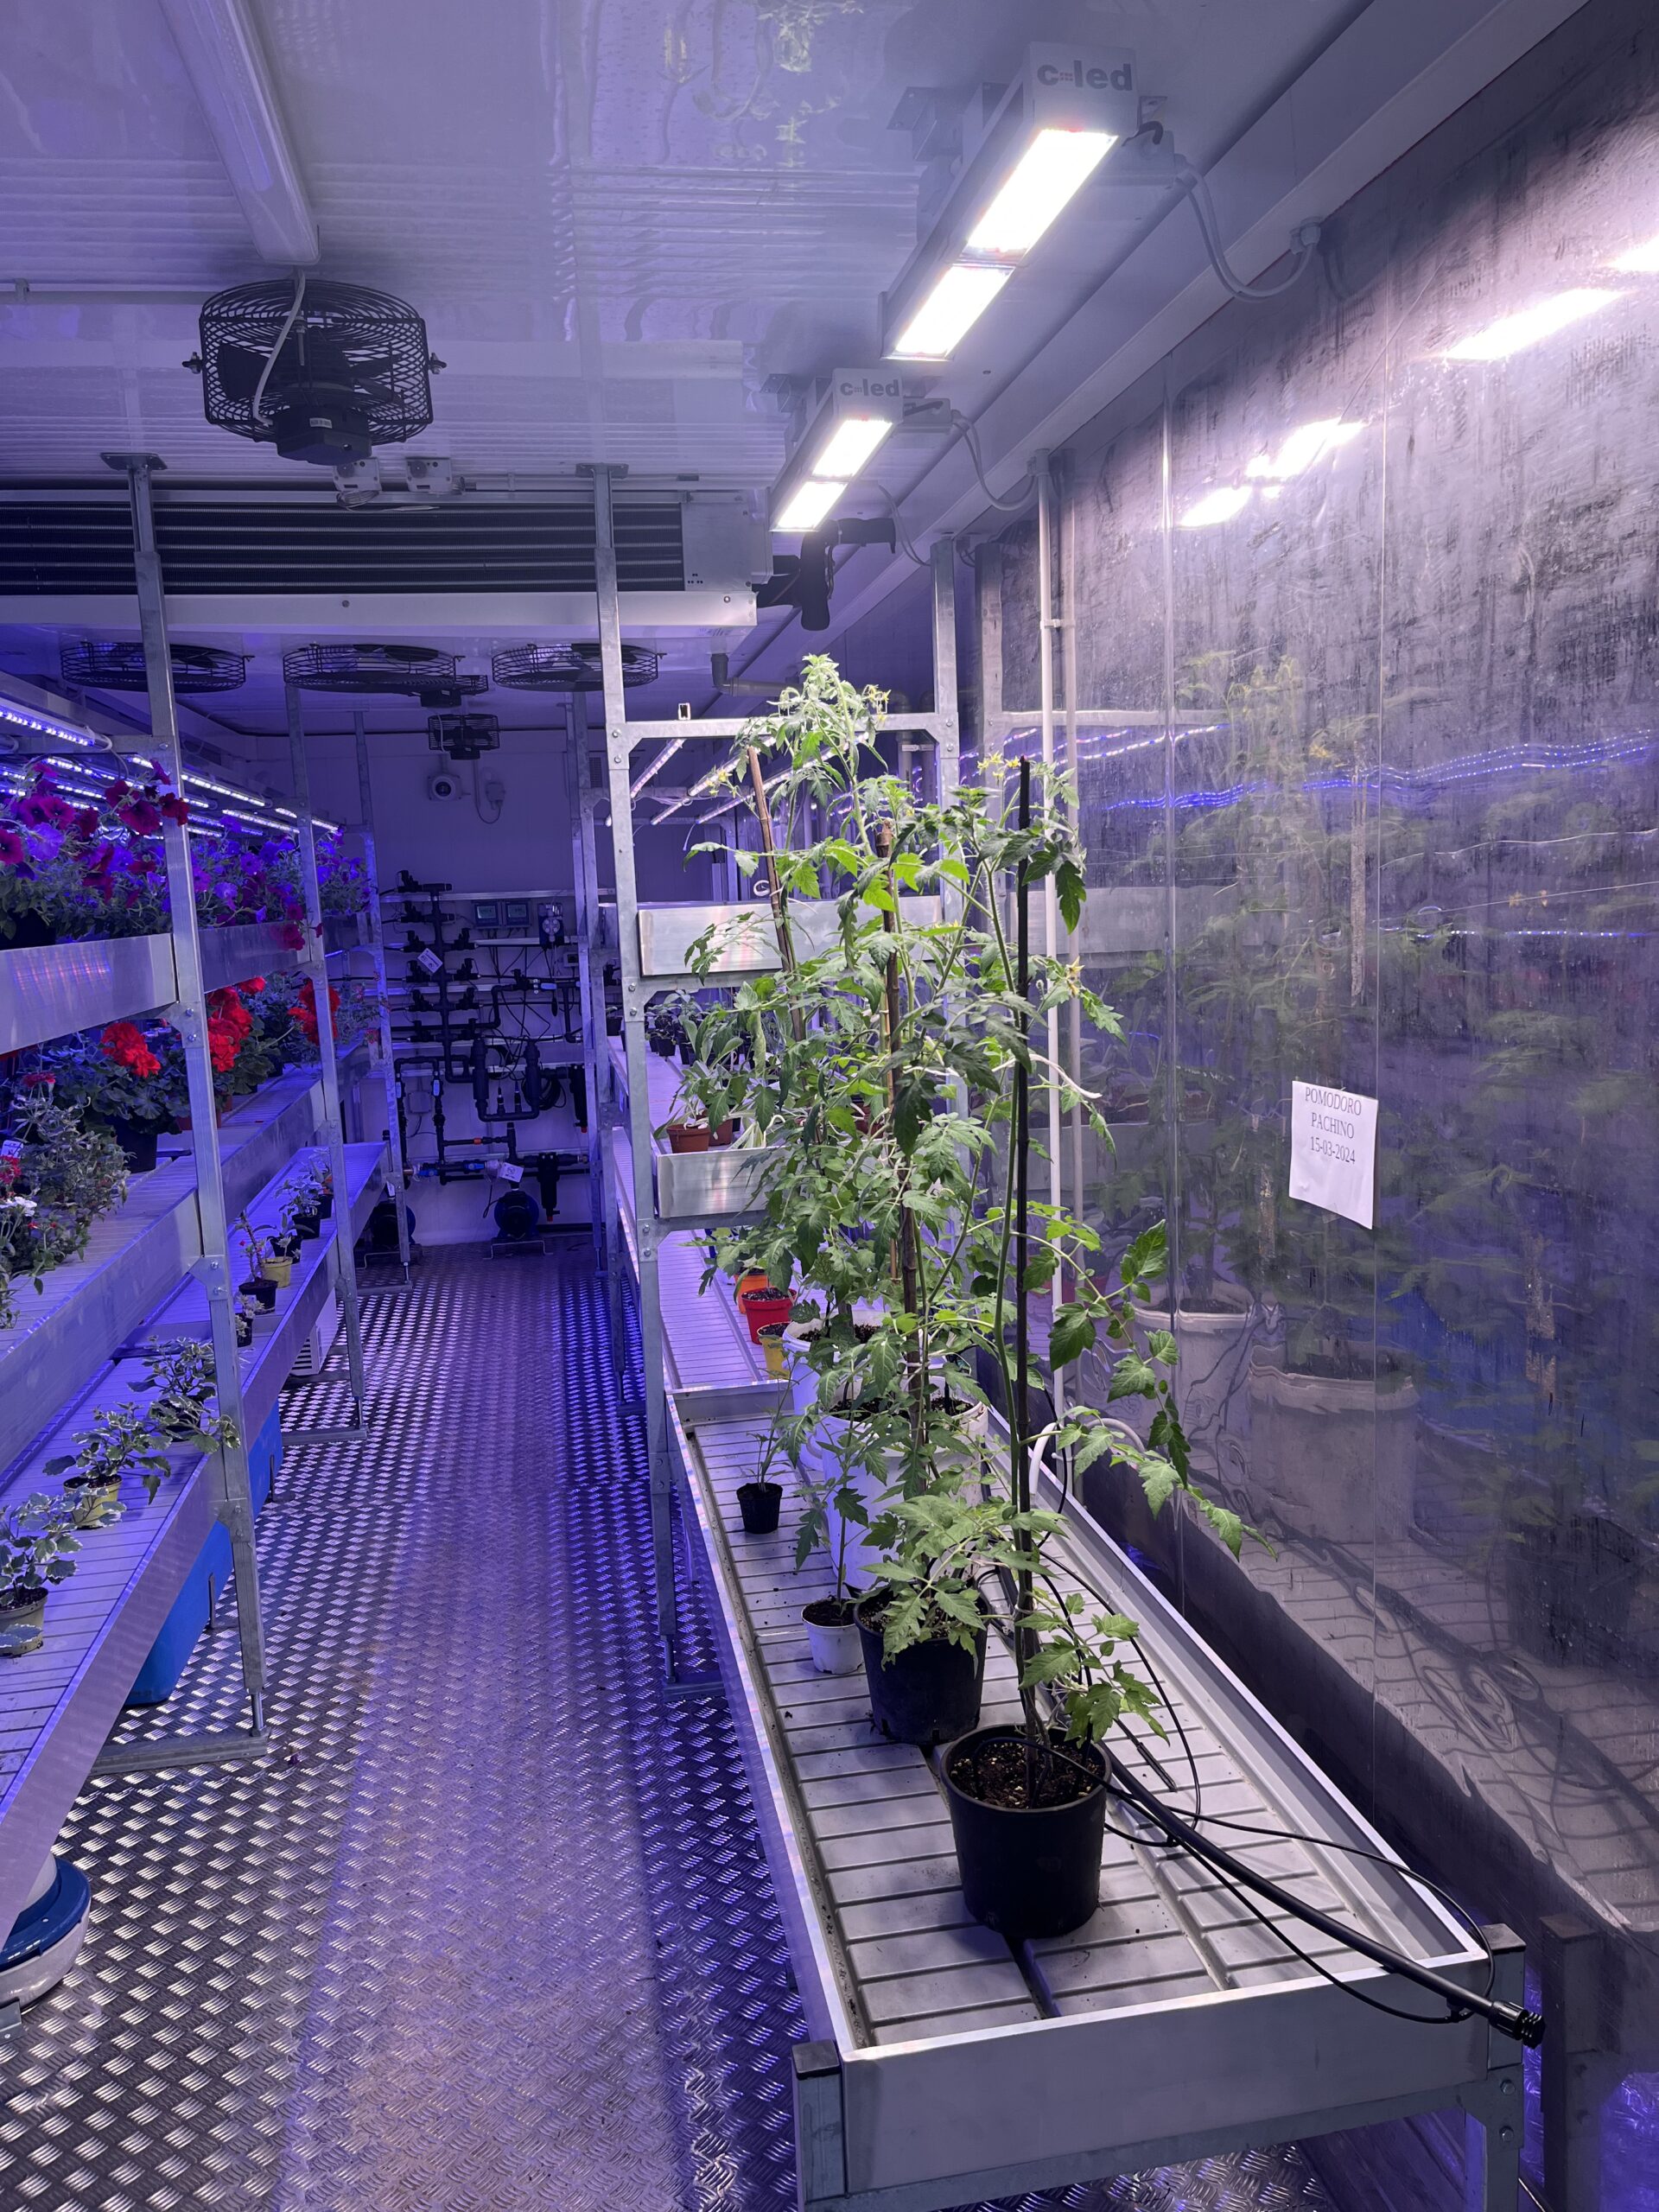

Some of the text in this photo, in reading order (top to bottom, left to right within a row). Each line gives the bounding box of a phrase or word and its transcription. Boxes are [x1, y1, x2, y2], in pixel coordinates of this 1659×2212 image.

[1305, 1086, 1362, 1116] POMODORO
[1311, 1112, 1354, 1139] PACHINO
[1310, 1136, 1356, 1164] 15-03-2024
